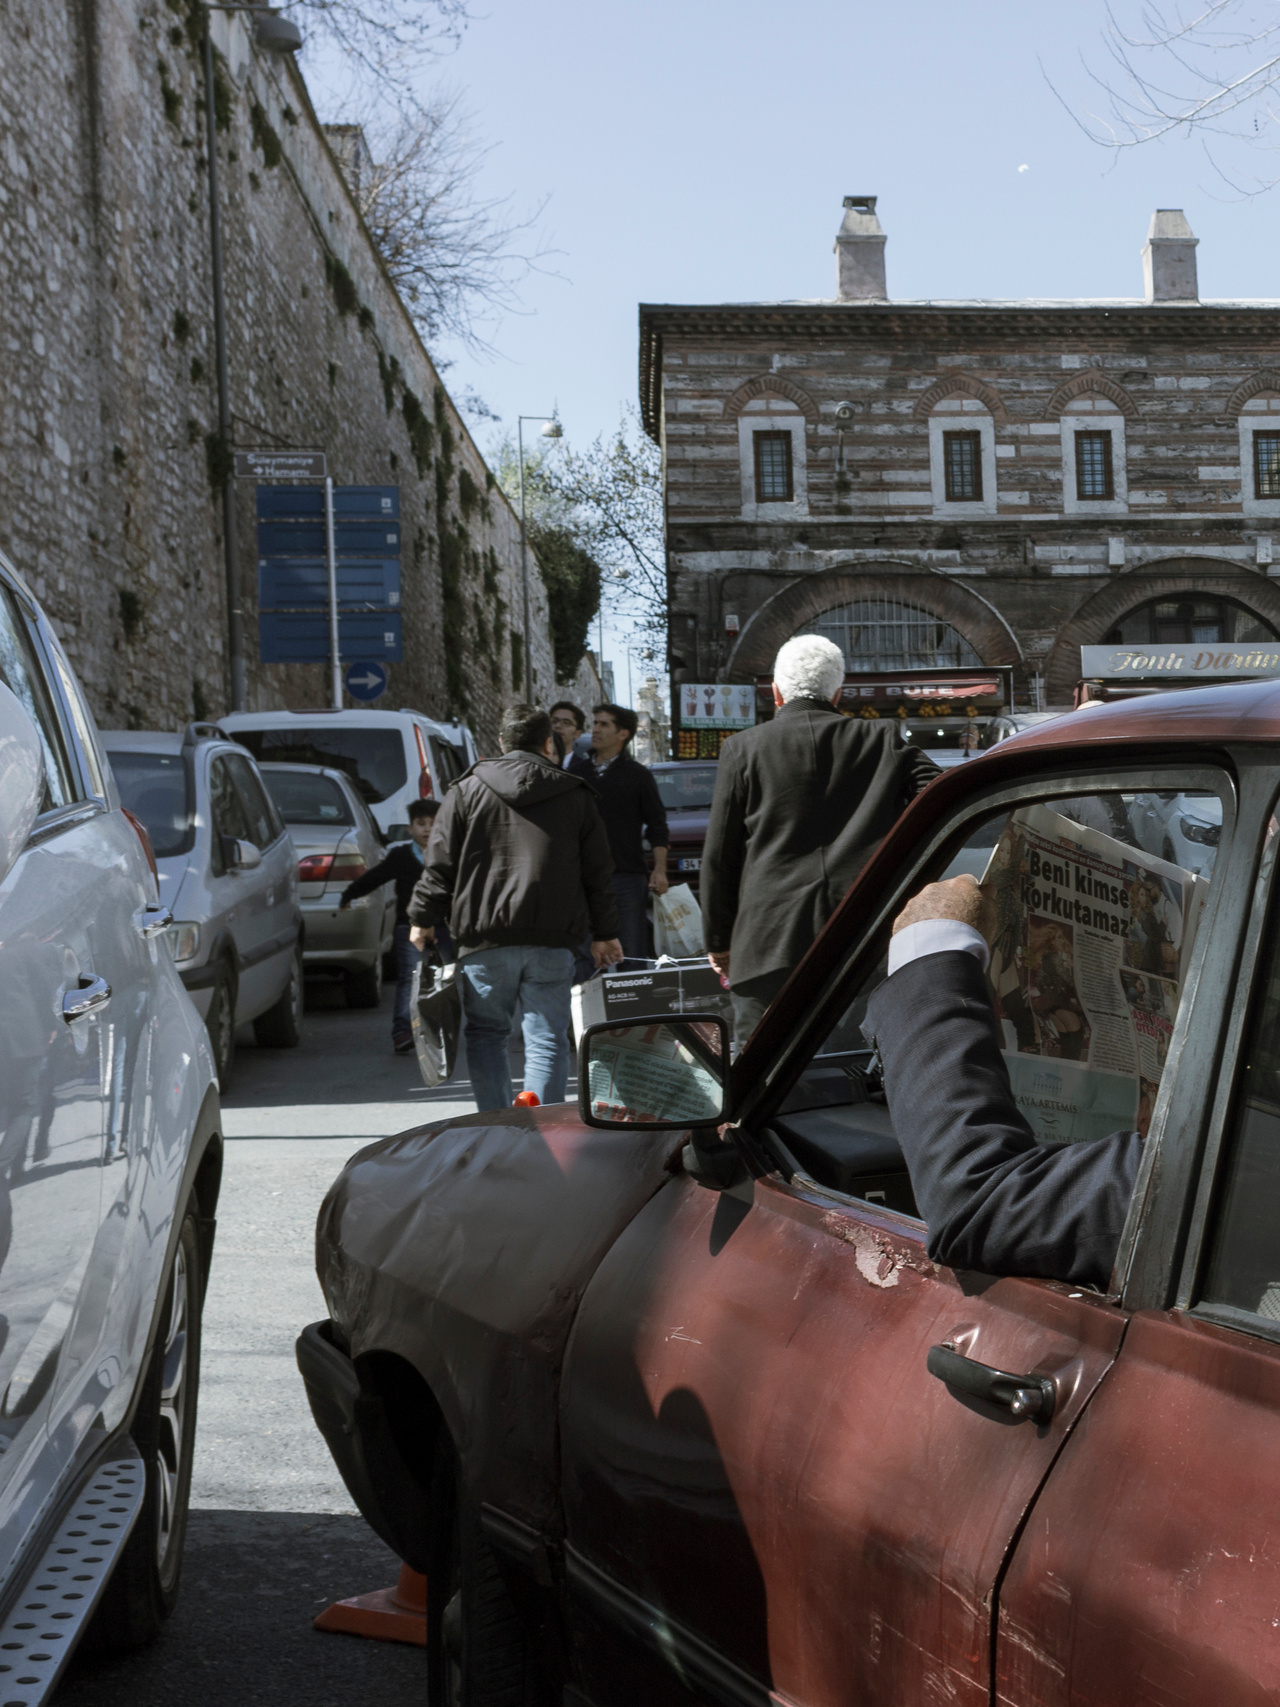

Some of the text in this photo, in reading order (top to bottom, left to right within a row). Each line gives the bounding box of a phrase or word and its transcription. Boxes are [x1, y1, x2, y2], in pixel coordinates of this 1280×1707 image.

[886, 684, 954, 697] BÜFE
[1075, 865, 1129, 909] kimse
[605, 976, 653, 989] Panasonic
